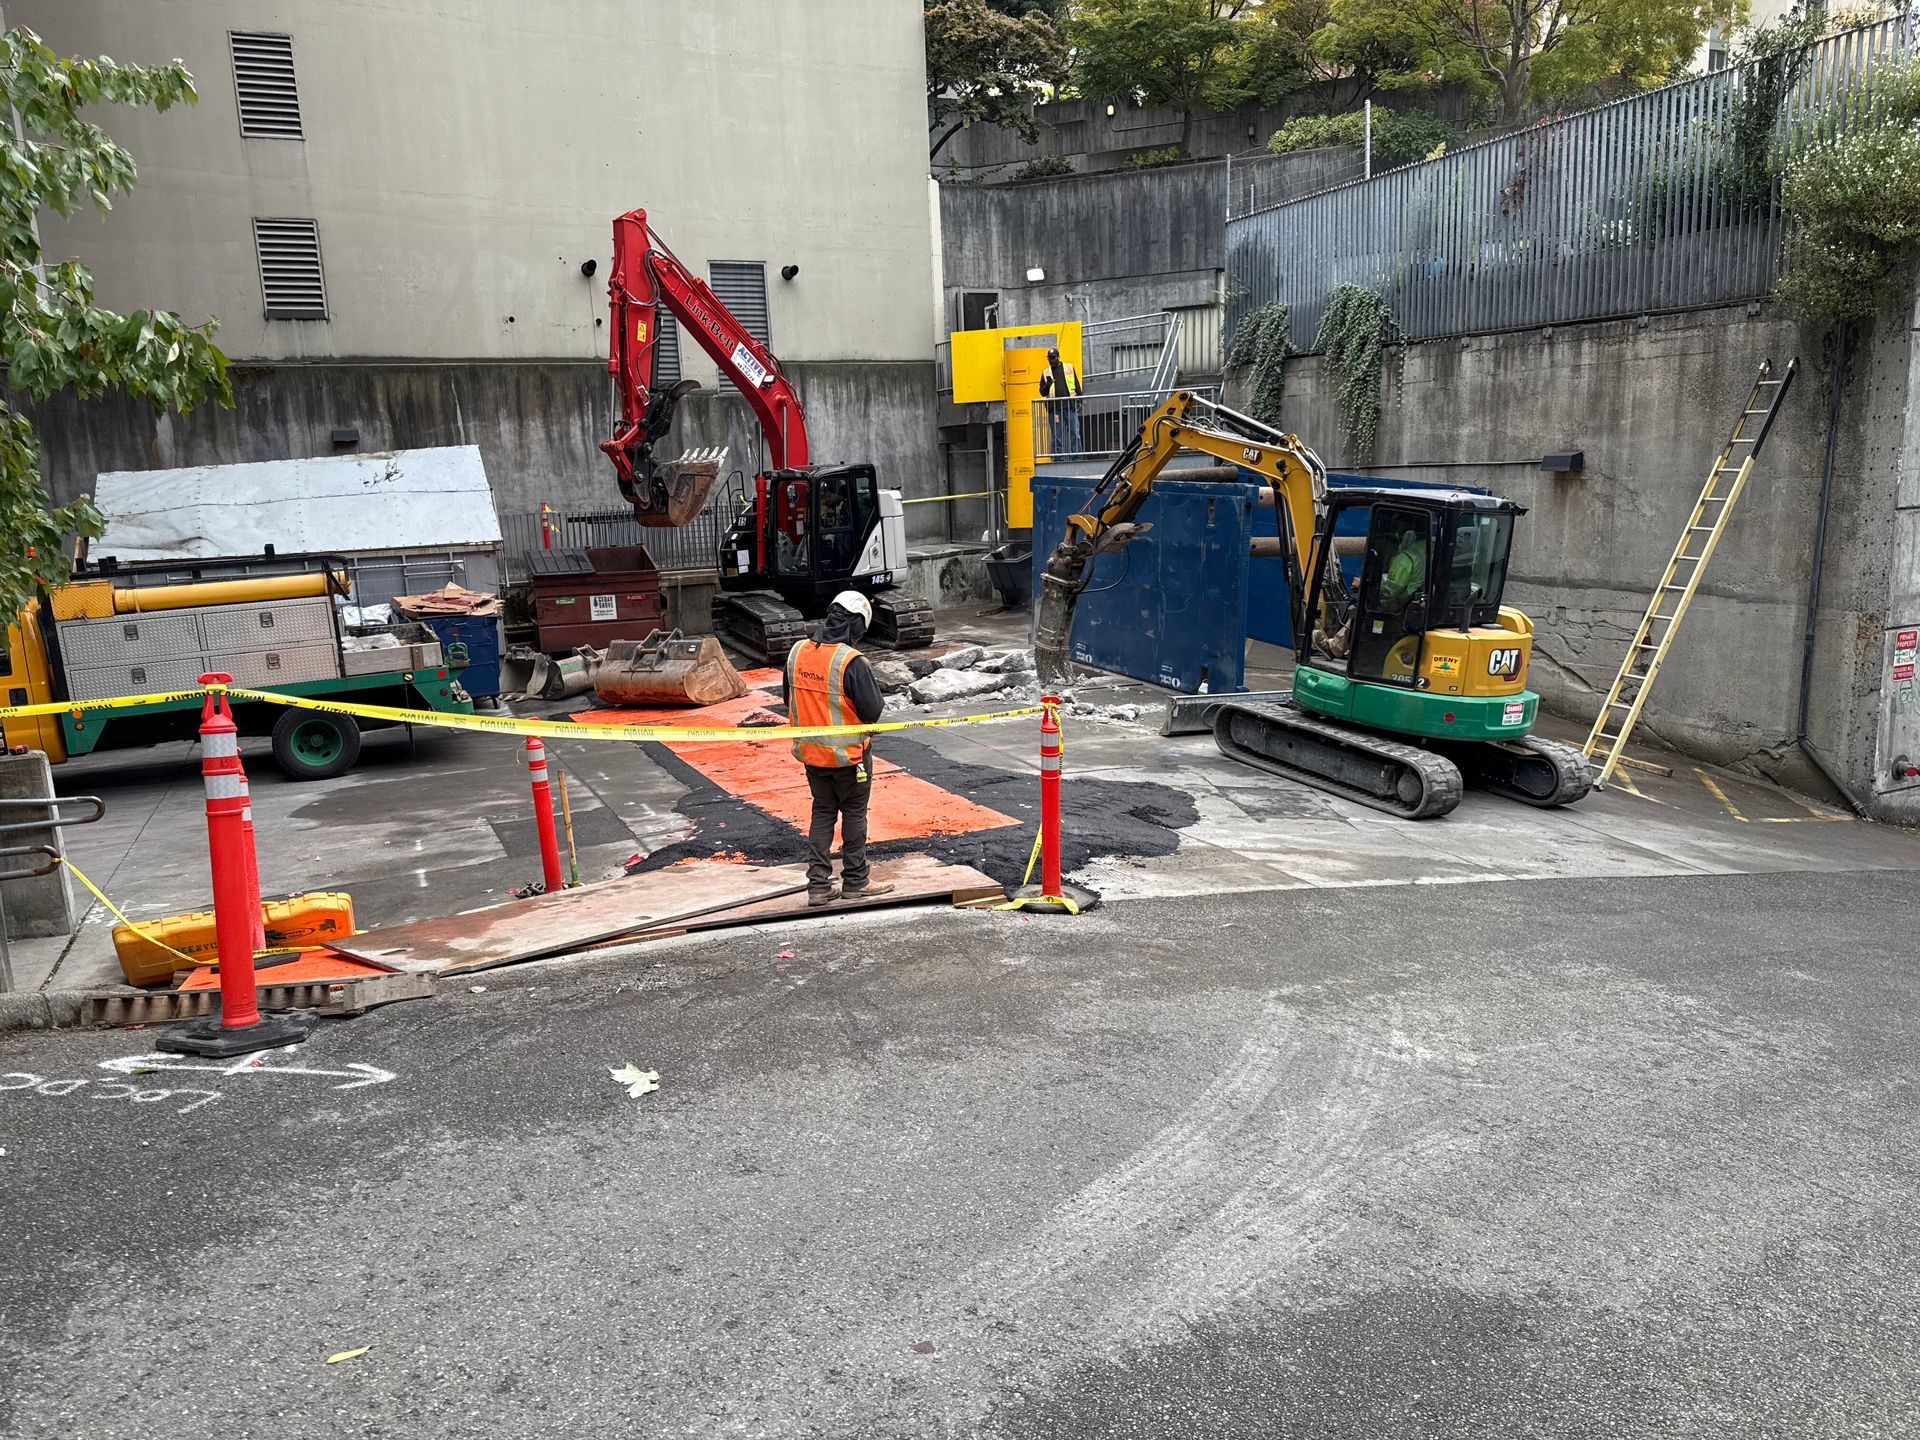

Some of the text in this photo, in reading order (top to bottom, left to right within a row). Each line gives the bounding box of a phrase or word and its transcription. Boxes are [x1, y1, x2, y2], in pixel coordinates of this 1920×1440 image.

[737, 346, 765, 376] ACTIVE
[1242, 447, 1260, 461] CAT
[1433, 656, 1459, 664] DEENY
[1488, 649, 1520, 675] CAT
